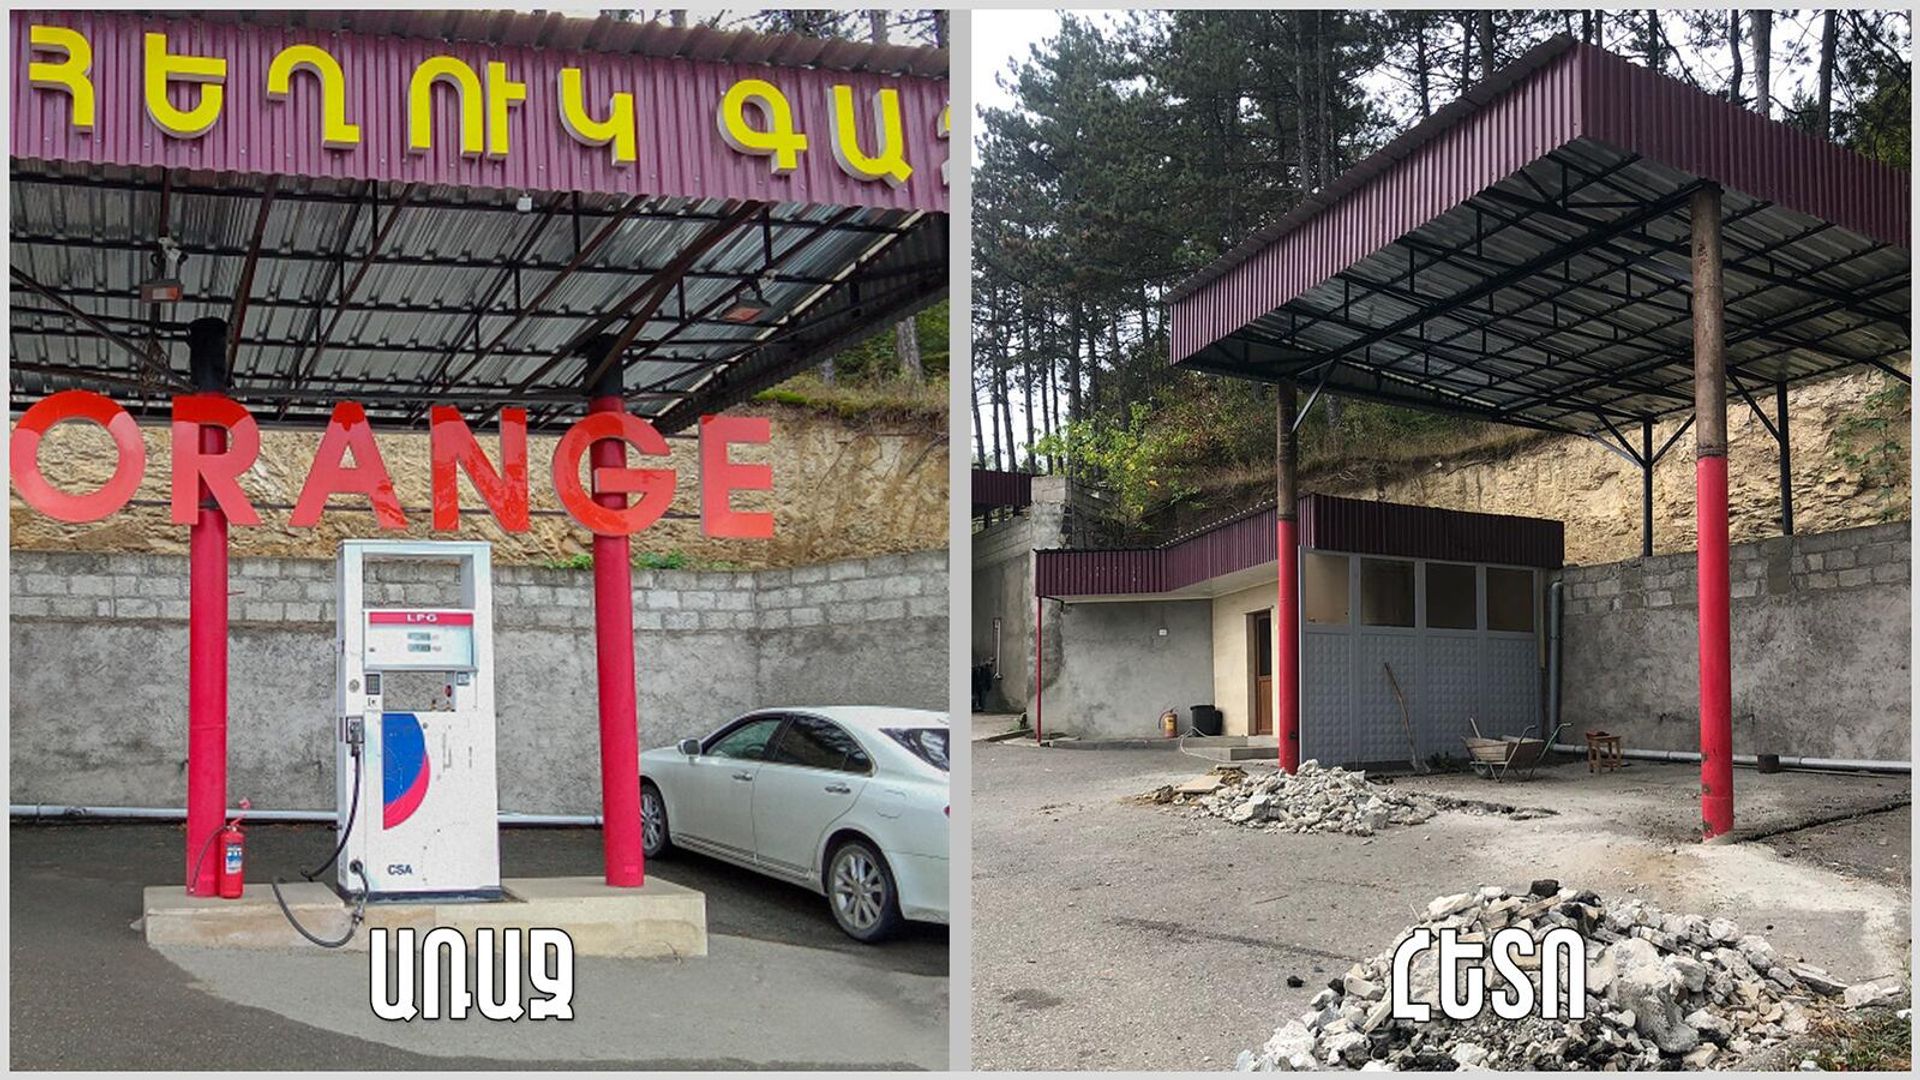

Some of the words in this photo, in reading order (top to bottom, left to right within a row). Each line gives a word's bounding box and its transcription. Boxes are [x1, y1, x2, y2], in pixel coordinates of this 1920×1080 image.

[28, 25, 637, 168] ՀԵՂՈՒԿ
[717, 79, 949, 188] ԳԱ
[9, 390, 774, 539] ORANGE
[406, 613, 438, 622] LPG
[387, 864, 412, 875] CSA
